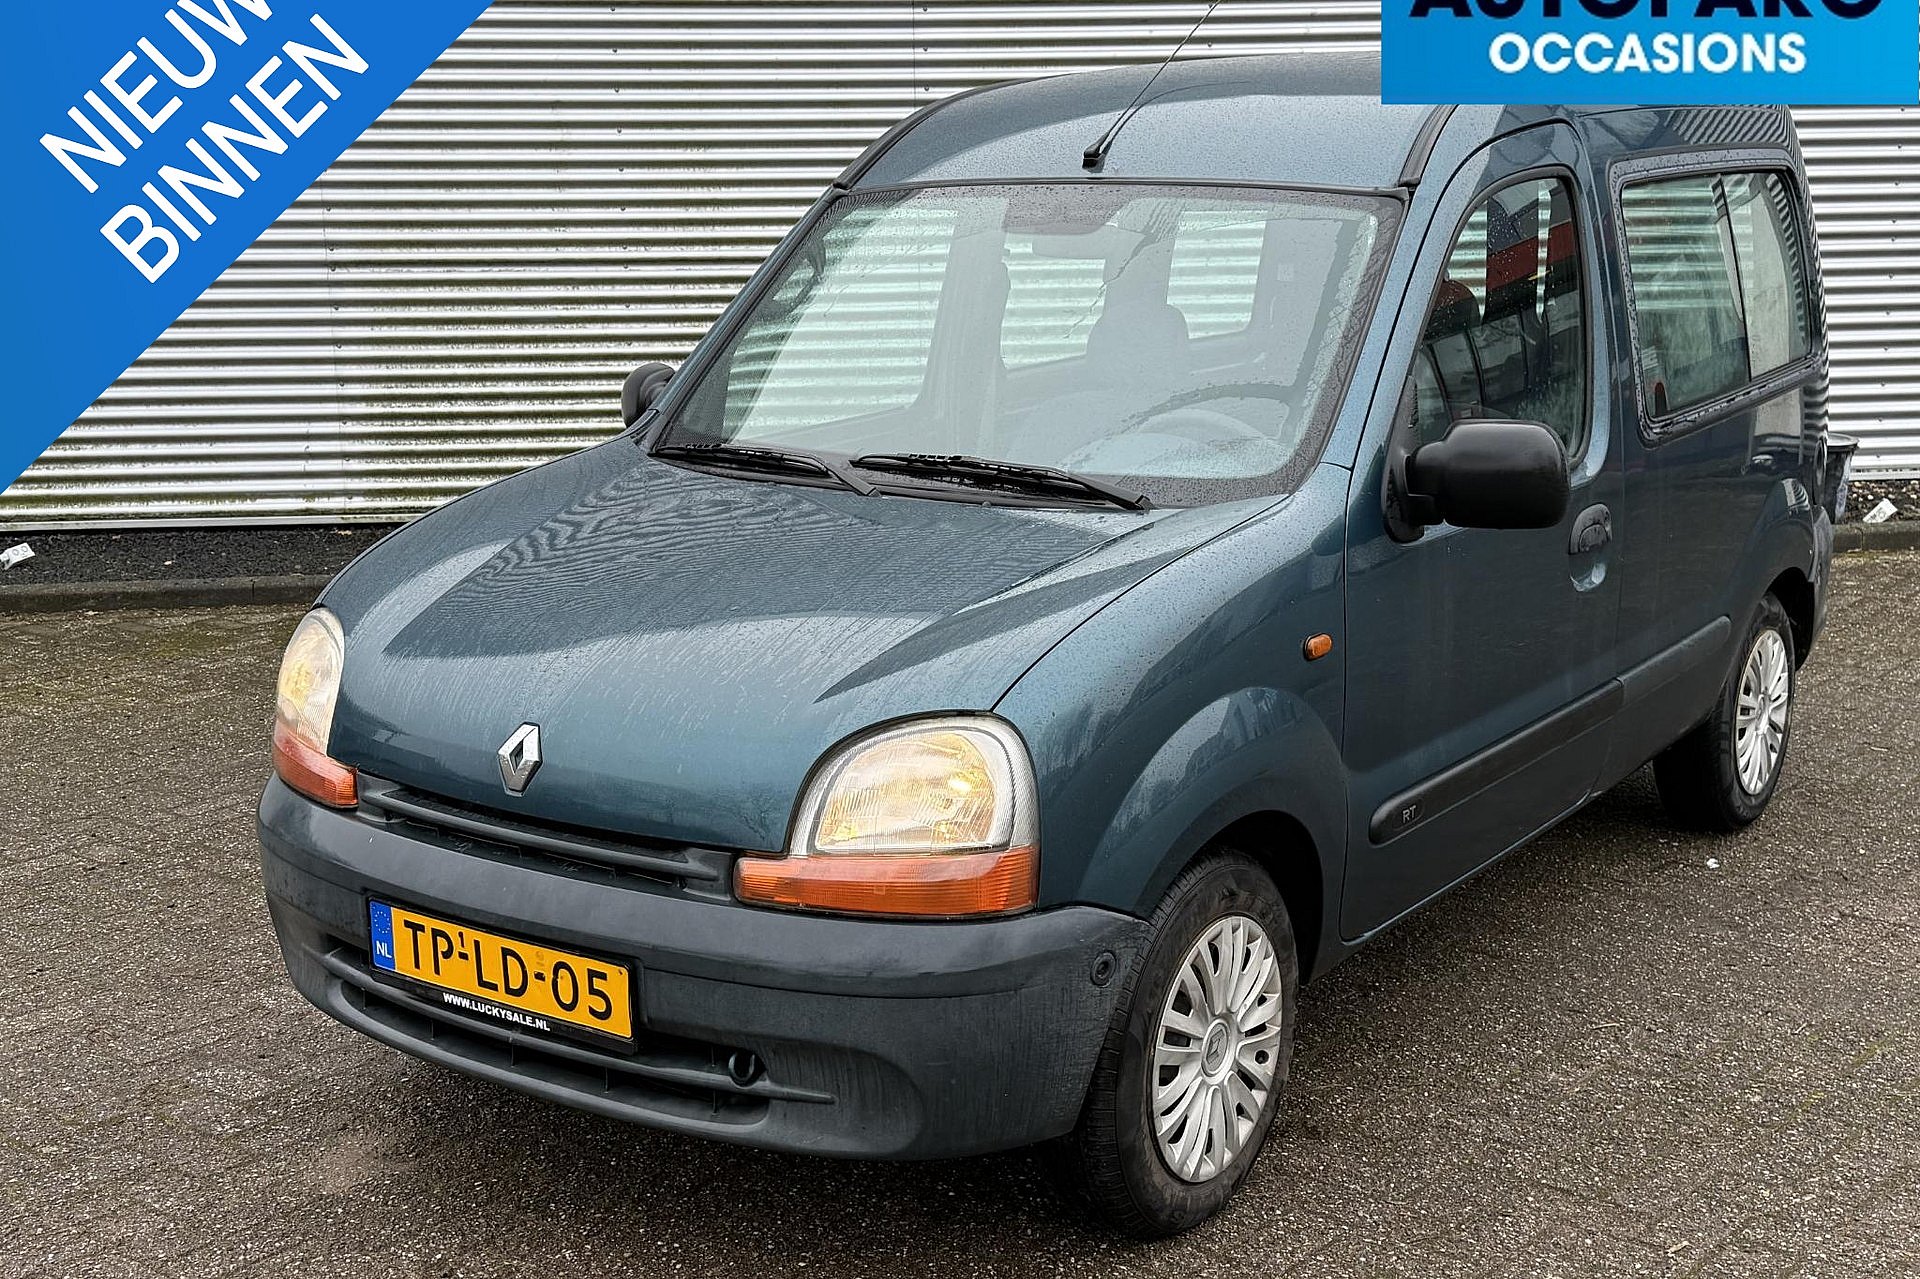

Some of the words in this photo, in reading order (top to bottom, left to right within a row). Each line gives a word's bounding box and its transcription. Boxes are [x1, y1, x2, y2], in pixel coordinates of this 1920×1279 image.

[1402, 804, 1417, 823] RT
[376, 940, 392, 958] NL
[443, 992, 551, 1032] WWW.LUCKYSALE.NL
